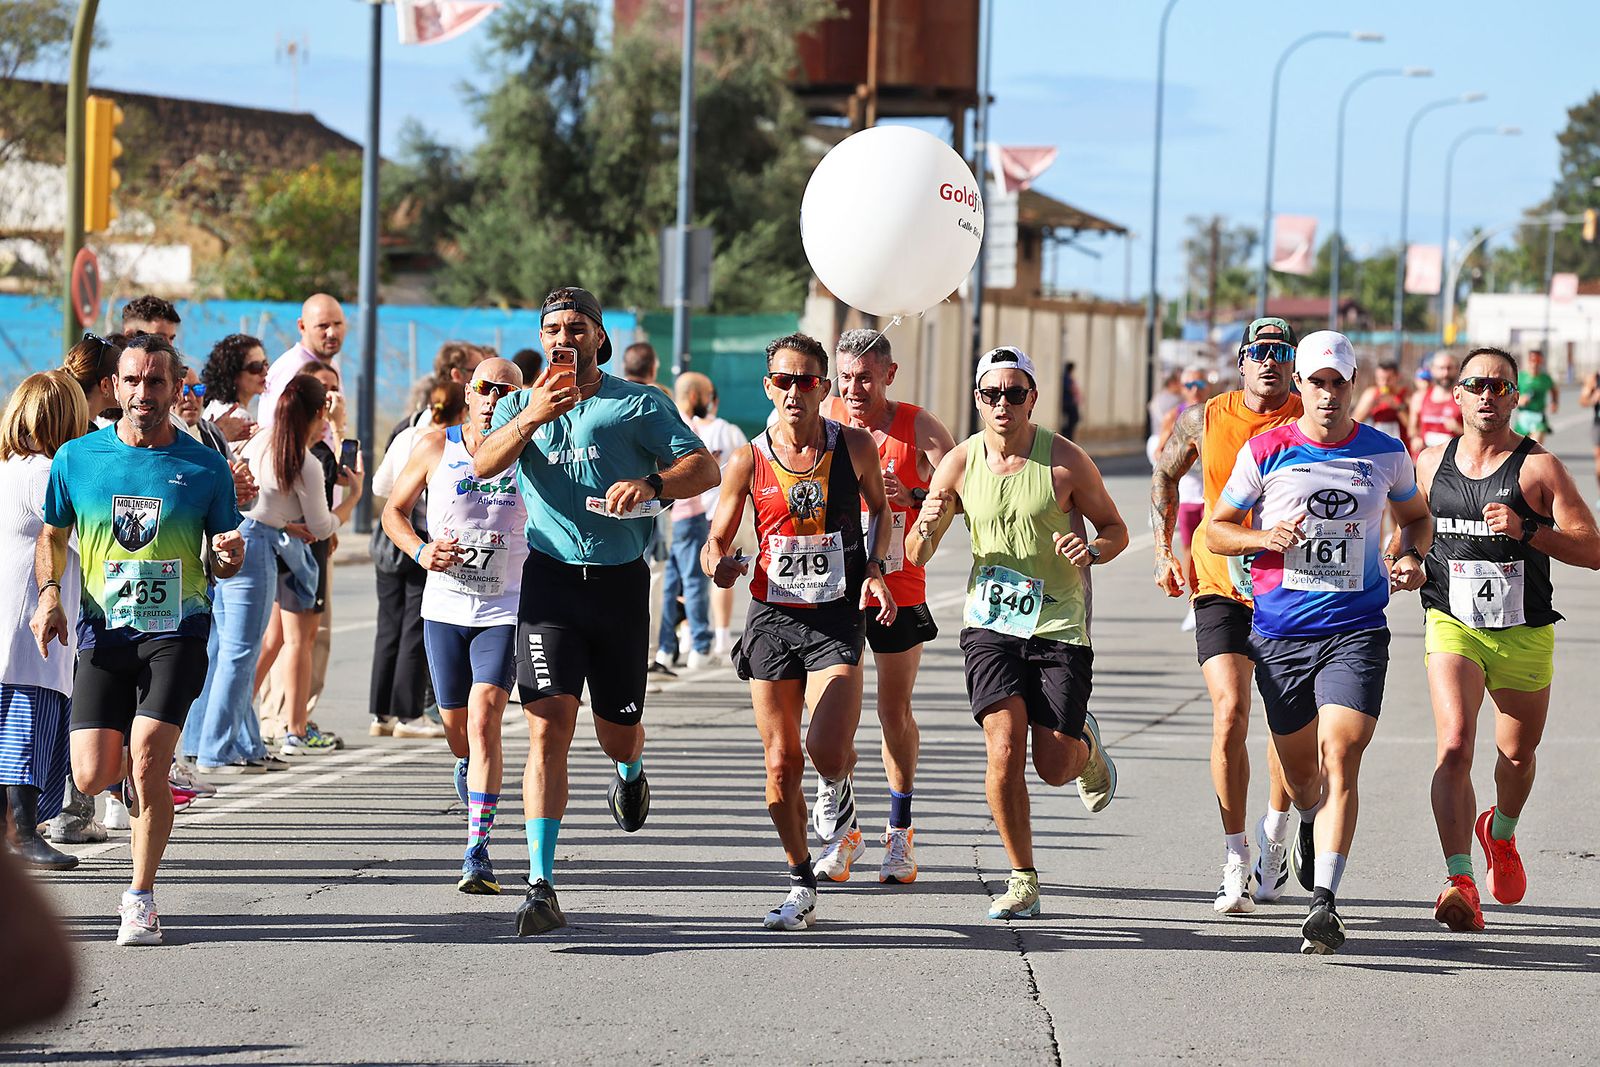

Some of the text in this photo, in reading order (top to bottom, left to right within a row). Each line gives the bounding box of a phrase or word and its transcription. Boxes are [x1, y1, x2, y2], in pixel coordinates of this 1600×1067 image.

[116, 499, 158, 510] MOLINEROS
[477, 497, 516, 507] Atletismo
[1300, 539, 1347, 564] 161
[778, 553, 829, 578] 219
[1294, 568, 1351, 577] ZABALA GOMEZ
[468, 573, 500, 583] SANCHEZ
[117, 580, 167, 605] 465
[980, 580, 1035, 615] 1340
[1477, 579, 1495, 602] 4
[528, 633, 552, 691] BIKILA
